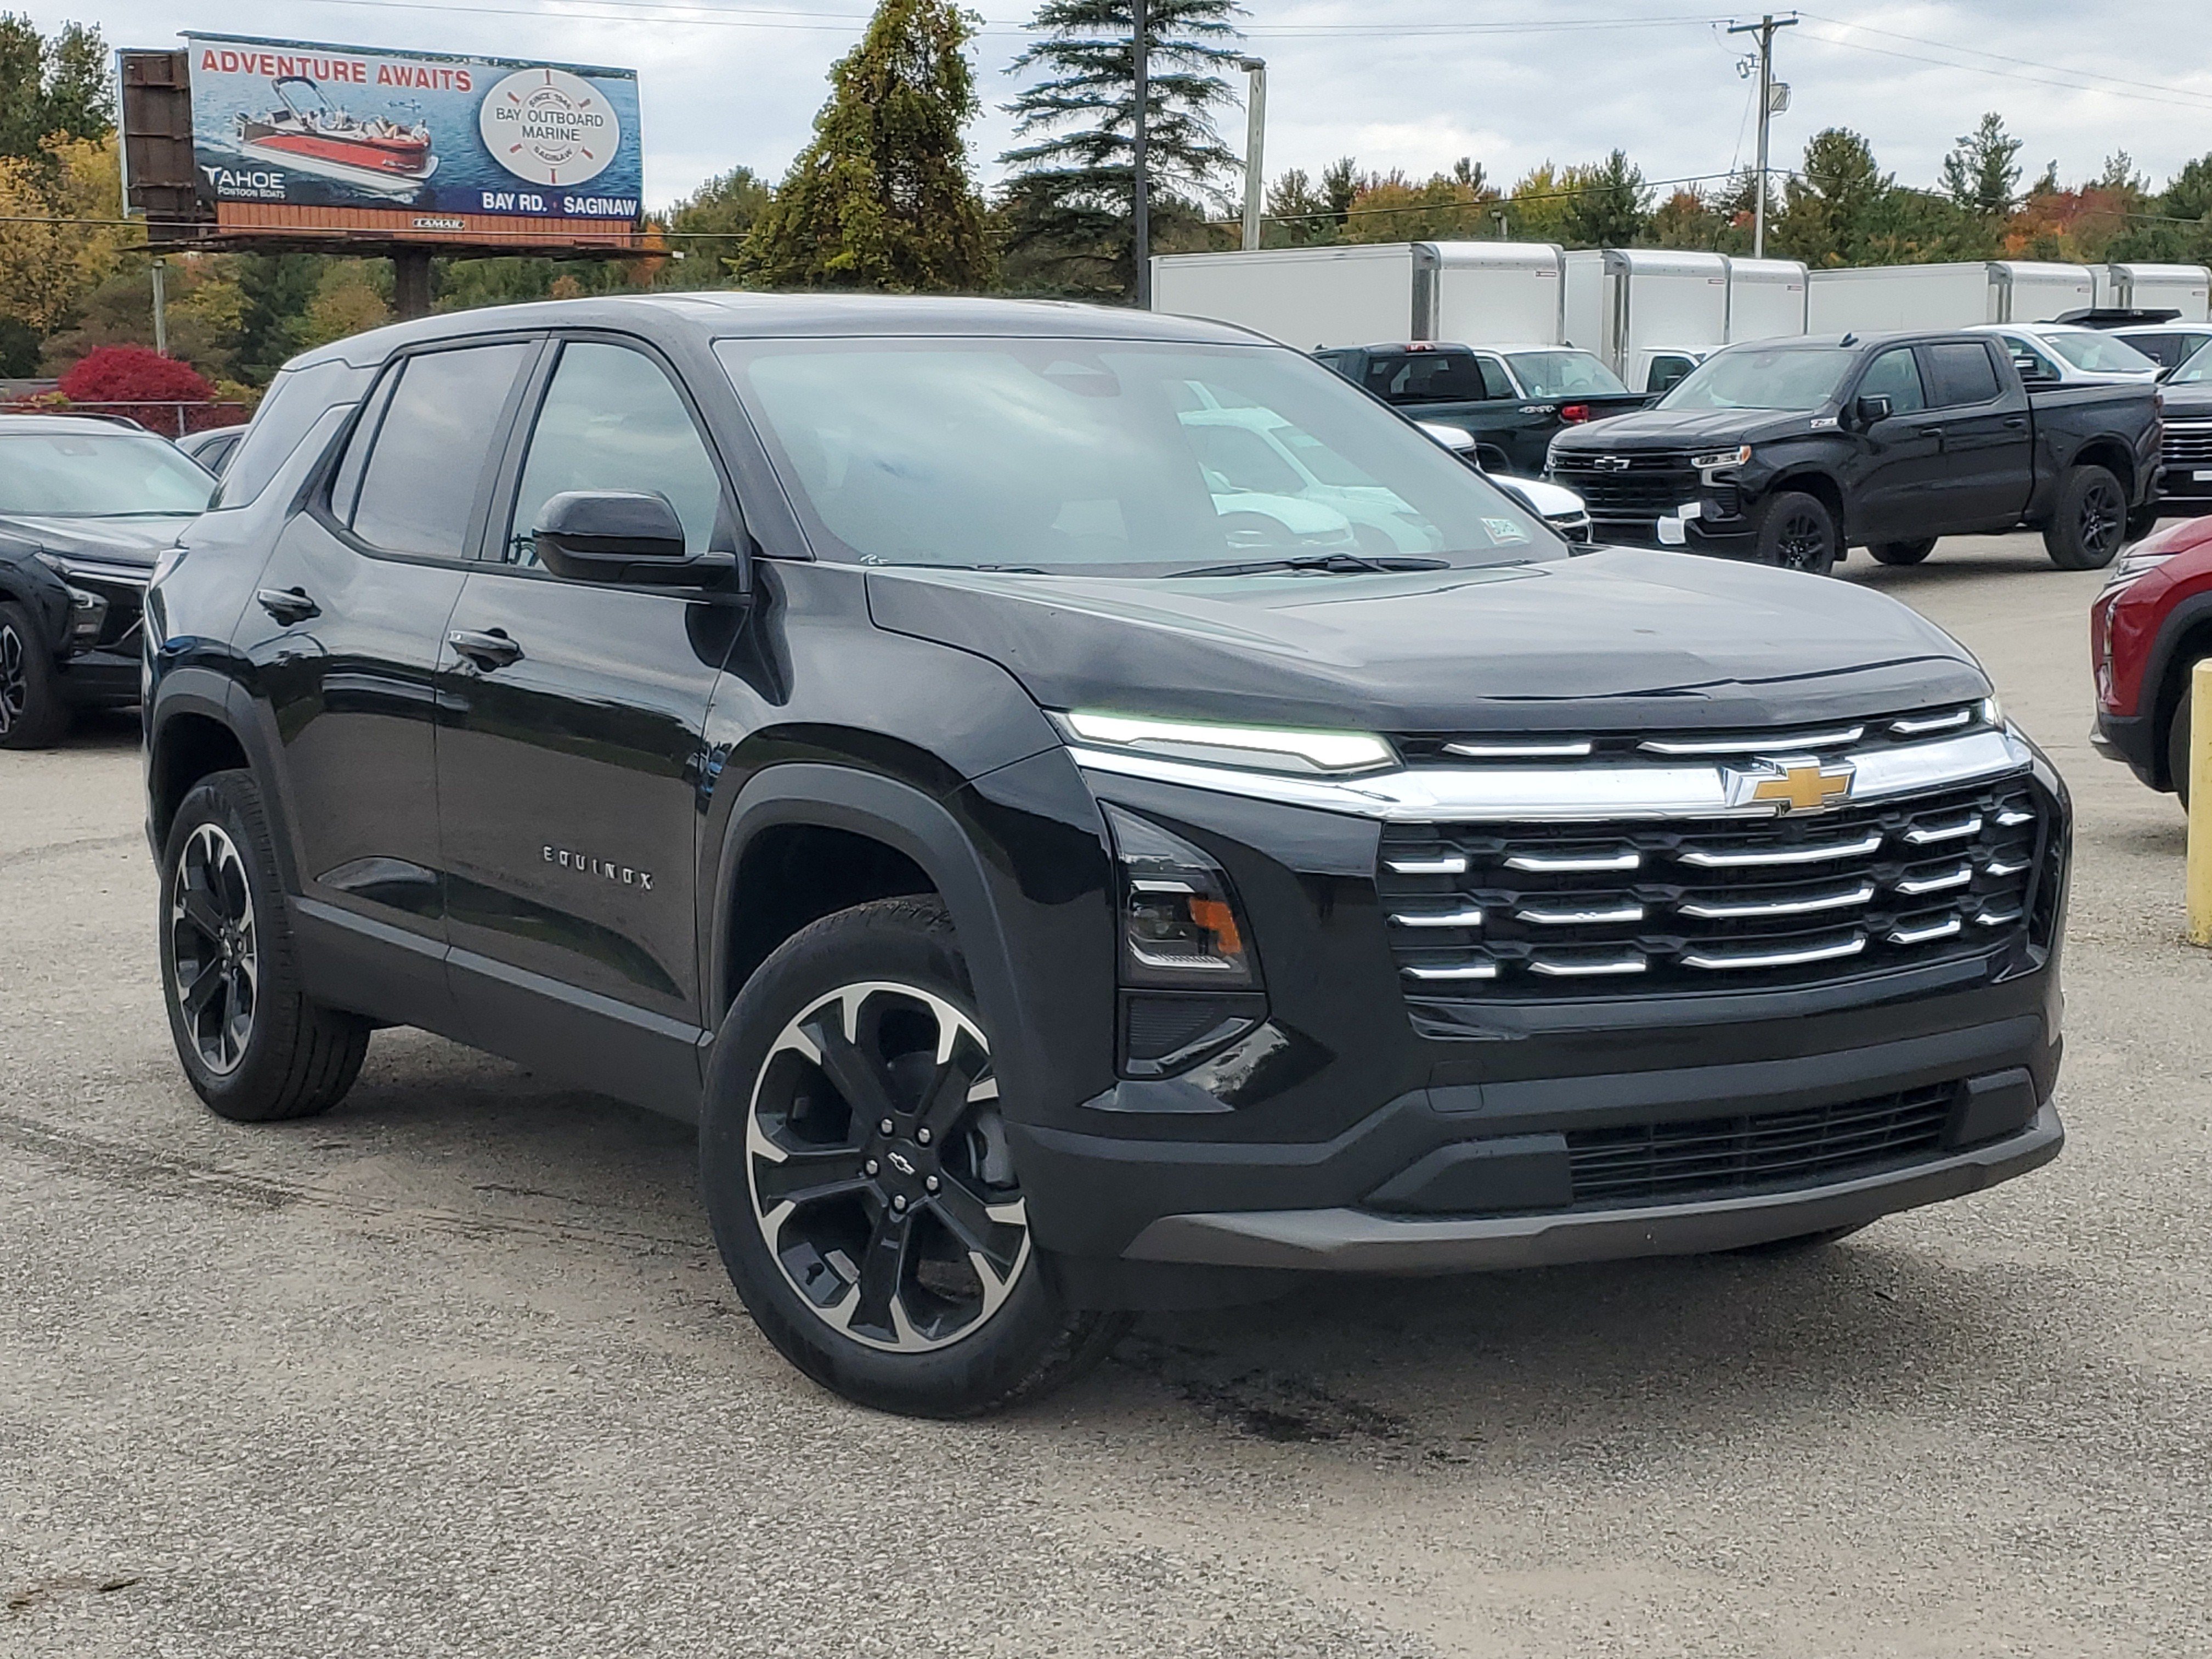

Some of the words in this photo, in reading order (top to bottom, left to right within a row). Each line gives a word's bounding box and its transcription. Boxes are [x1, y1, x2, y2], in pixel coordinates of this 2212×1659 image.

[201, 49, 367, 84] ADVENTURE
[377, 64, 472, 92] AWAITS
[528, 92, 551, 108] SINCE
[496, 108, 522, 121] BAY
[527, 110, 604, 127] OUTBOARD
[522, 125, 581, 142] MARINE
[199, 165, 285, 189] TAHOE
[482, 192, 515, 210] BAY
[518, 194, 548, 212] RD.
[563, 196, 637, 216] SAGINAW
[543, 845, 652, 890] EQUINOX
